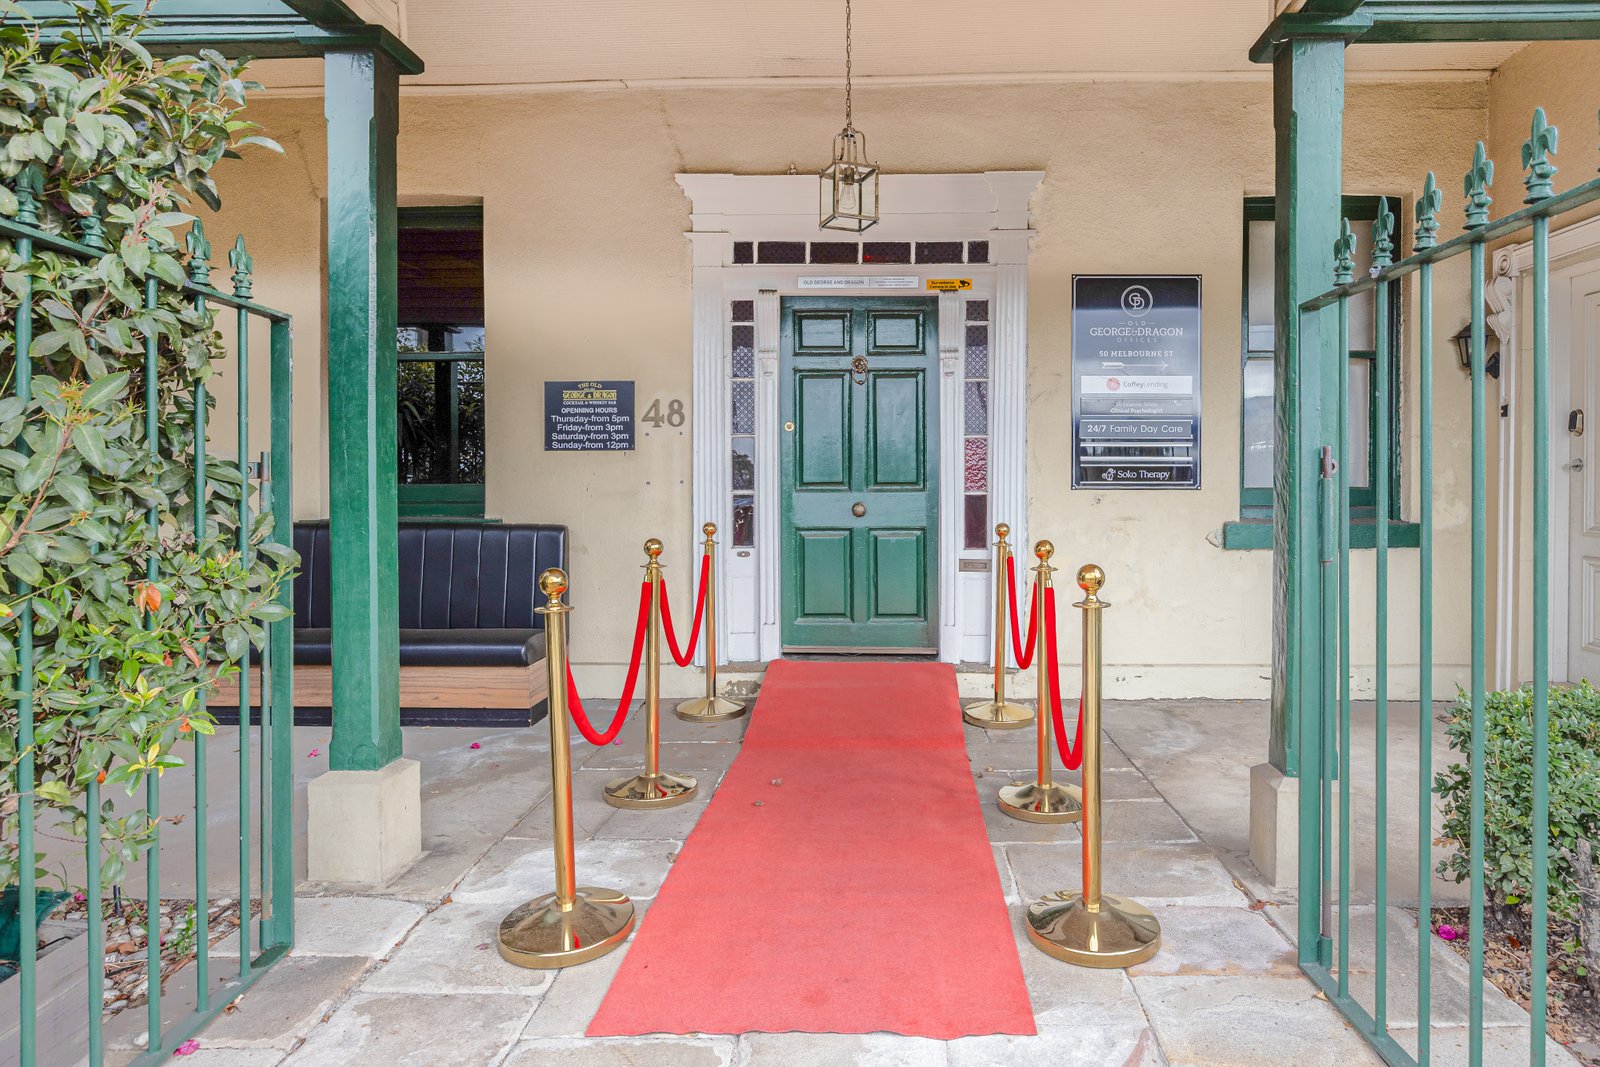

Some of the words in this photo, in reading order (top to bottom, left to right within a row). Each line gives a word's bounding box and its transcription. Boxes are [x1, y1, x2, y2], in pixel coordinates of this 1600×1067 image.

[641, 398, 685, 428] 48
[551, 415, 610, 423] Thursday-from
[611, 415, 629, 423] 5pm
[557, 424, 604, 432] Friday-from
[605, 424, 624, 432] 3pm
[1087, 424, 1106, 433] 24/7
[1110, 424, 1137, 434] Family
[1140, 424, 1158, 434] Day
[1161, 424, 1184, 433] Care
[551, 433, 610, 441] Saturday-from
[611, 433, 629, 441] 3pm
[551, 441, 606, 449] Sunday-from
[607, 441, 629, 449] 12pm
[1117, 470, 1137, 478] Soko
[1139, 470, 1170, 480] Therapy
